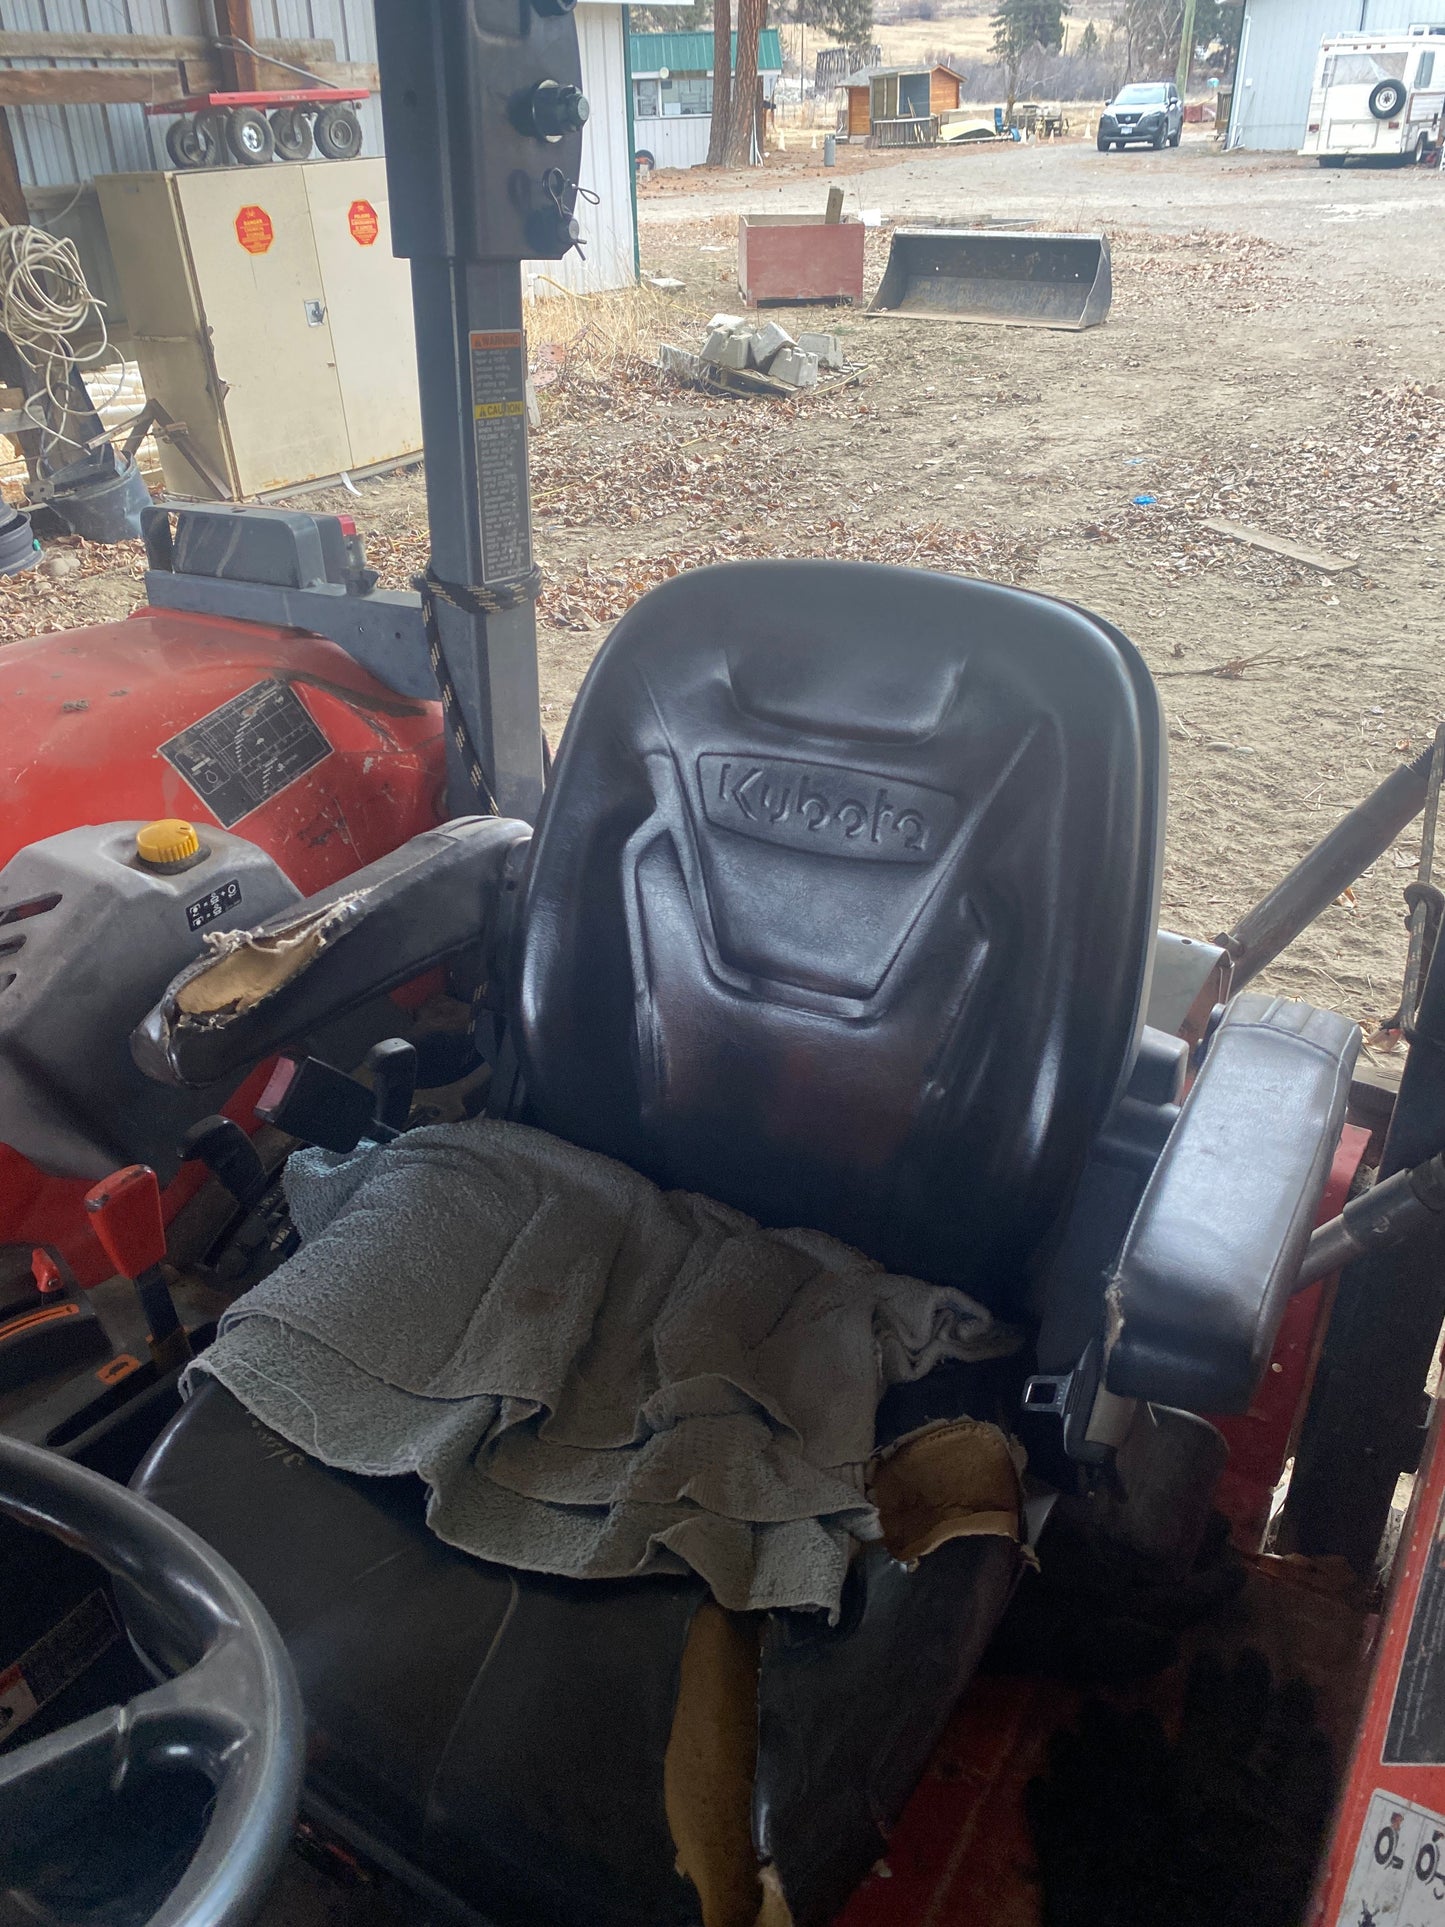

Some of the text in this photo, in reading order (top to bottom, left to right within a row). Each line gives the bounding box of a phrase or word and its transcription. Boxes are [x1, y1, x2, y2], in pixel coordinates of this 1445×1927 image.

[482, 335, 518, 346] WARNING
[487, 403, 521, 415] CAUION
[718, 763, 930, 851] Kubota
